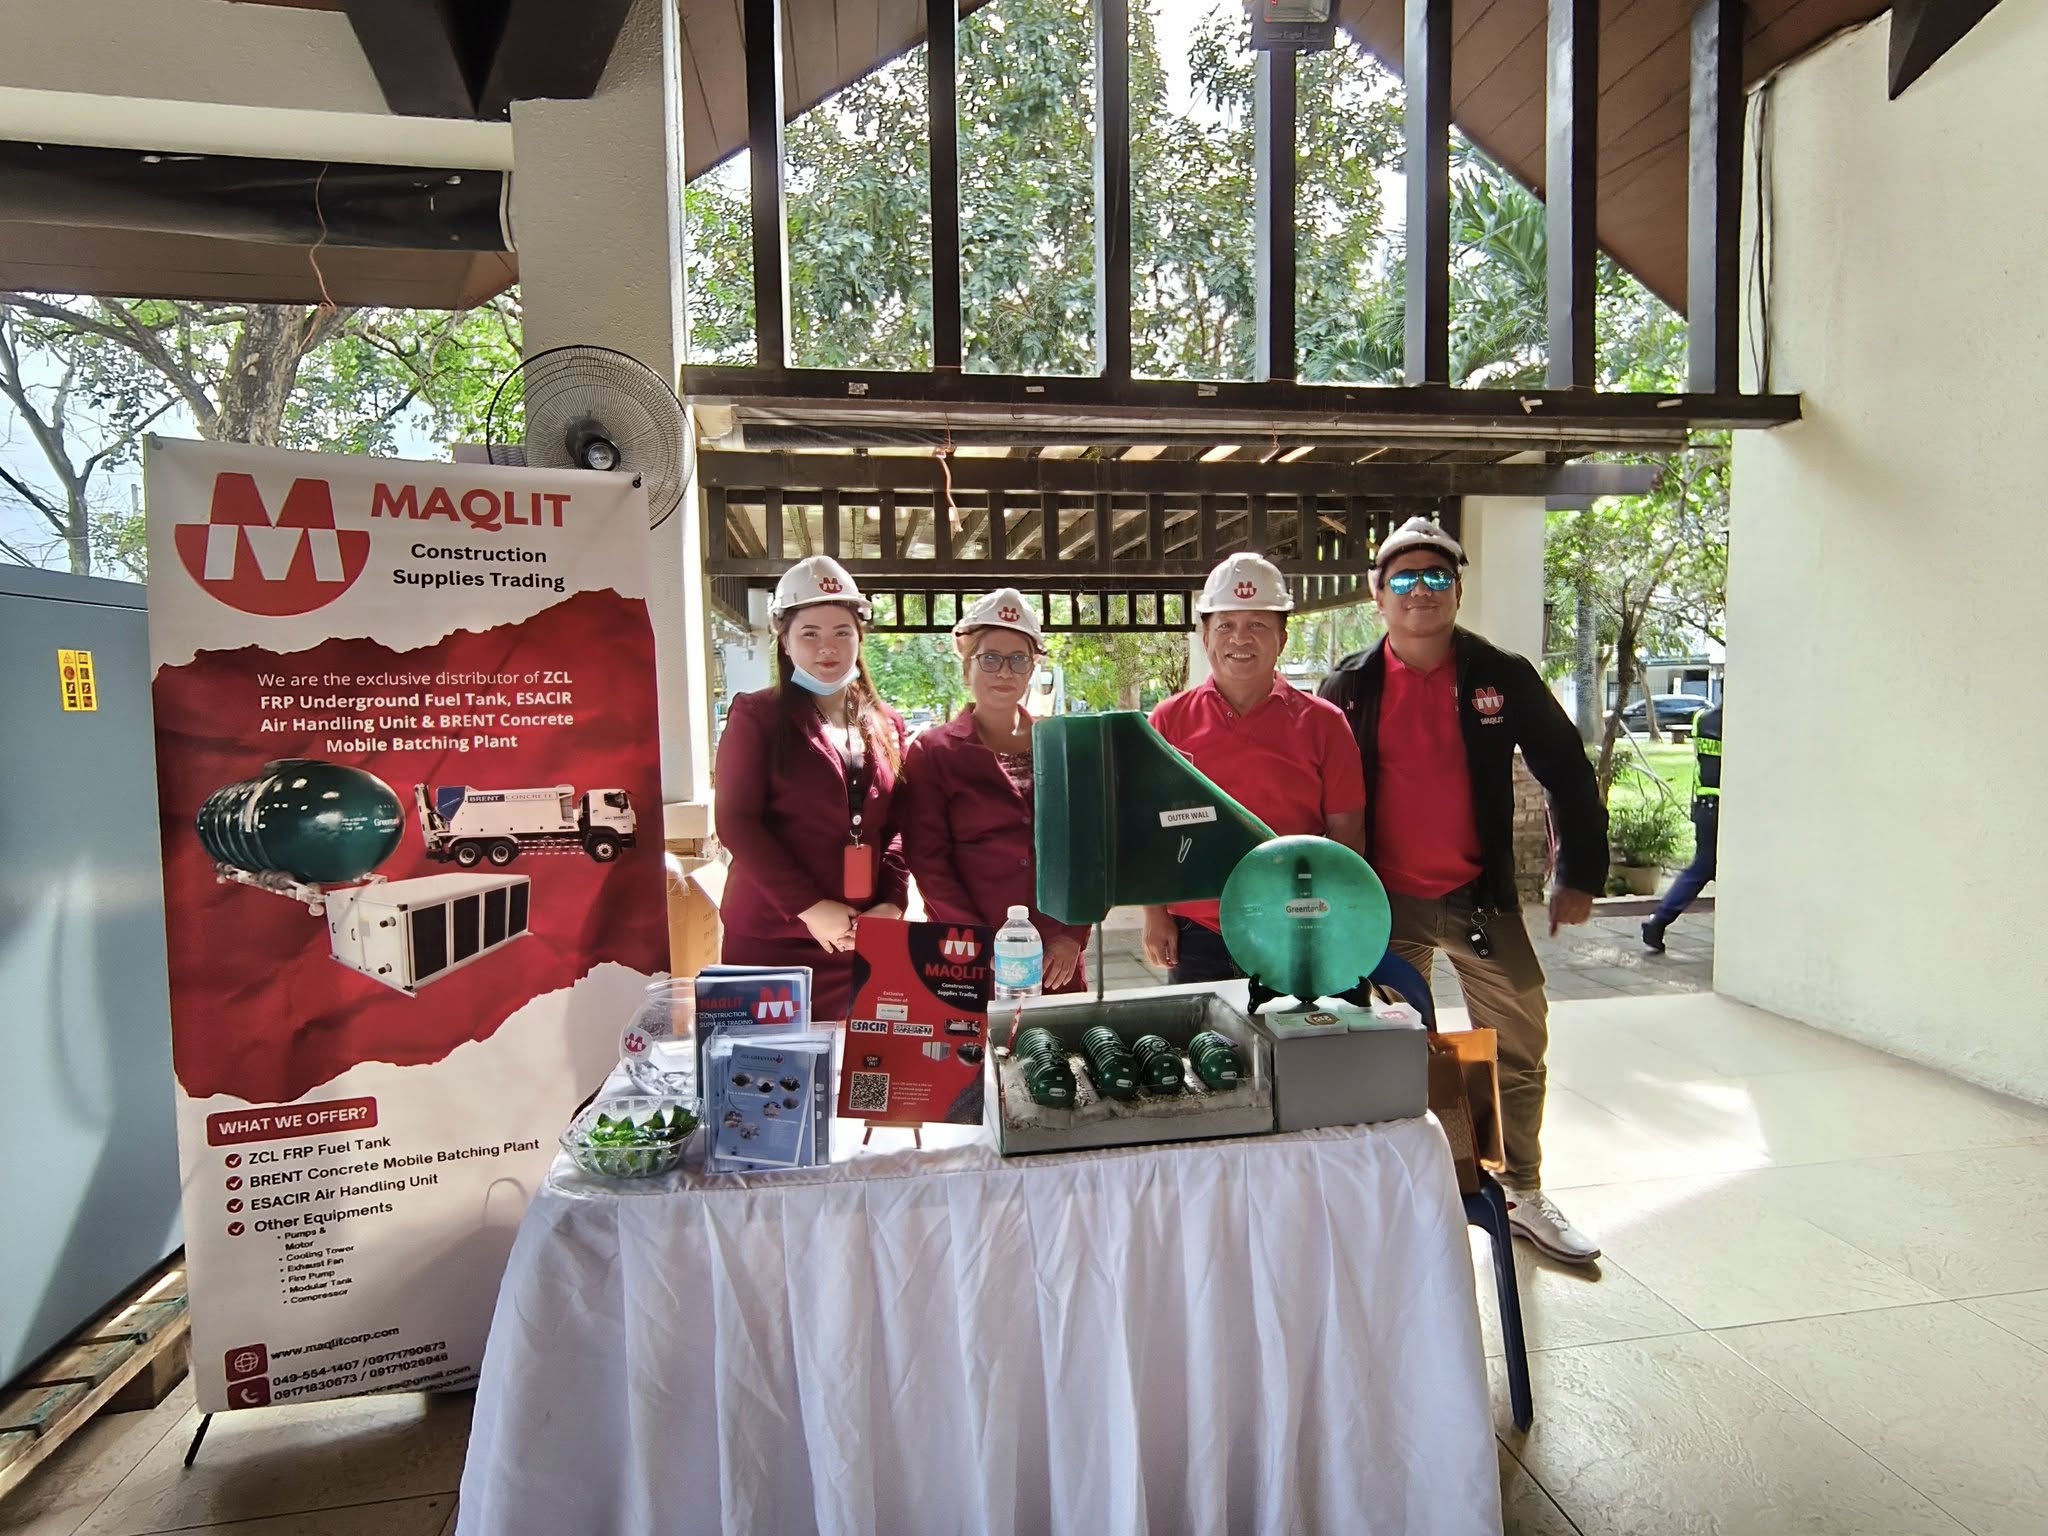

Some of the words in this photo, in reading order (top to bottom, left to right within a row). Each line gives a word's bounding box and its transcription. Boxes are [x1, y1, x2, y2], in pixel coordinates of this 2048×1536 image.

[371, 482, 572, 532] MAQLIT
[411, 543, 546, 562] Construction
[393, 569, 484, 589] Supplies
[490, 572, 565, 592] Trading
[257, 674, 286, 686] We
[290, 675, 318, 686] are
[324, 672, 350, 686] the
[356, 672, 430, 686] exclusive
[436, 672, 519, 685] distributor
[524, 671, 540, 684] of
[543, 672, 572, 684] ZCL
[260, 696, 294, 710] FRP
[300, 693, 420, 711] Underground
[424, 693, 460, 706] Fuel
[465, 692, 512, 707] Tank,
[516, 692, 572, 705] ESACIR
[260, 718, 287, 732] Air
[293, 716, 374, 733] Handling
[379, 716, 417, 729] Unit
[422, 715, 435, 728] &
[440, 714, 495, 727] BRENT
[500, 713, 574, 726] Concrete
[1480, 716, 1504, 725] MAQLIT
[326, 738, 388, 752] Mobile
[393, 736, 470, 752] Batching
[474, 735, 518, 748] Plant
[1168, 813, 1190, 822] OUTER
[1191, 811, 1210, 819] WALL
[925, 963, 988, 980] MAQLIT
[942, 982, 974, 990] Construction
[852, 1022, 887, 1032] ESACIR
[218, 1118, 271, 1135] WHAT
[274, 1114, 302, 1129] WE
[306, 1106, 368, 1126] OFFER?
[249, 1151, 280, 1164] ZCL
[284, 1146, 314, 1160] FRP
[318, 1142, 350, 1156] Fuel
[355, 1136, 391, 1150] Tank
[250, 1170, 303, 1188] BRENT
[308, 1162, 379, 1180] Concrete
[384, 1154, 433, 1169] Mobile
[437, 1146, 500, 1162] Batching
[504, 1139, 540, 1152] Plant
[251, 1192, 310, 1210] ESACIR
[314, 1188, 336, 1201] Air
[340, 1179, 406, 1198] Handling
[410, 1174, 438, 1187] Unit
[254, 1217, 300, 1232] Other
[304, 1202, 393, 1225] Equipments
[284, 1229, 316, 1240] Pumps
[319, 1226, 326, 1234] &
[285, 1240, 314, 1250] Motor
[286, 1250, 323, 1262] Cooling
[326, 1246, 354, 1255] Tower
[288, 1260, 324, 1272] Exhaust
[326, 1258, 344, 1266] Fan
[308, 1270, 336, 1280] Pump
[290, 1282, 328, 1293] Modular
[331, 1278, 352, 1286] Tank
[290, 1289, 348, 1304] Compressor
[270, 1327, 400, 1360] www.maqlitcorp.com
[272, 1360, 359, 1386] 049-554-1407
